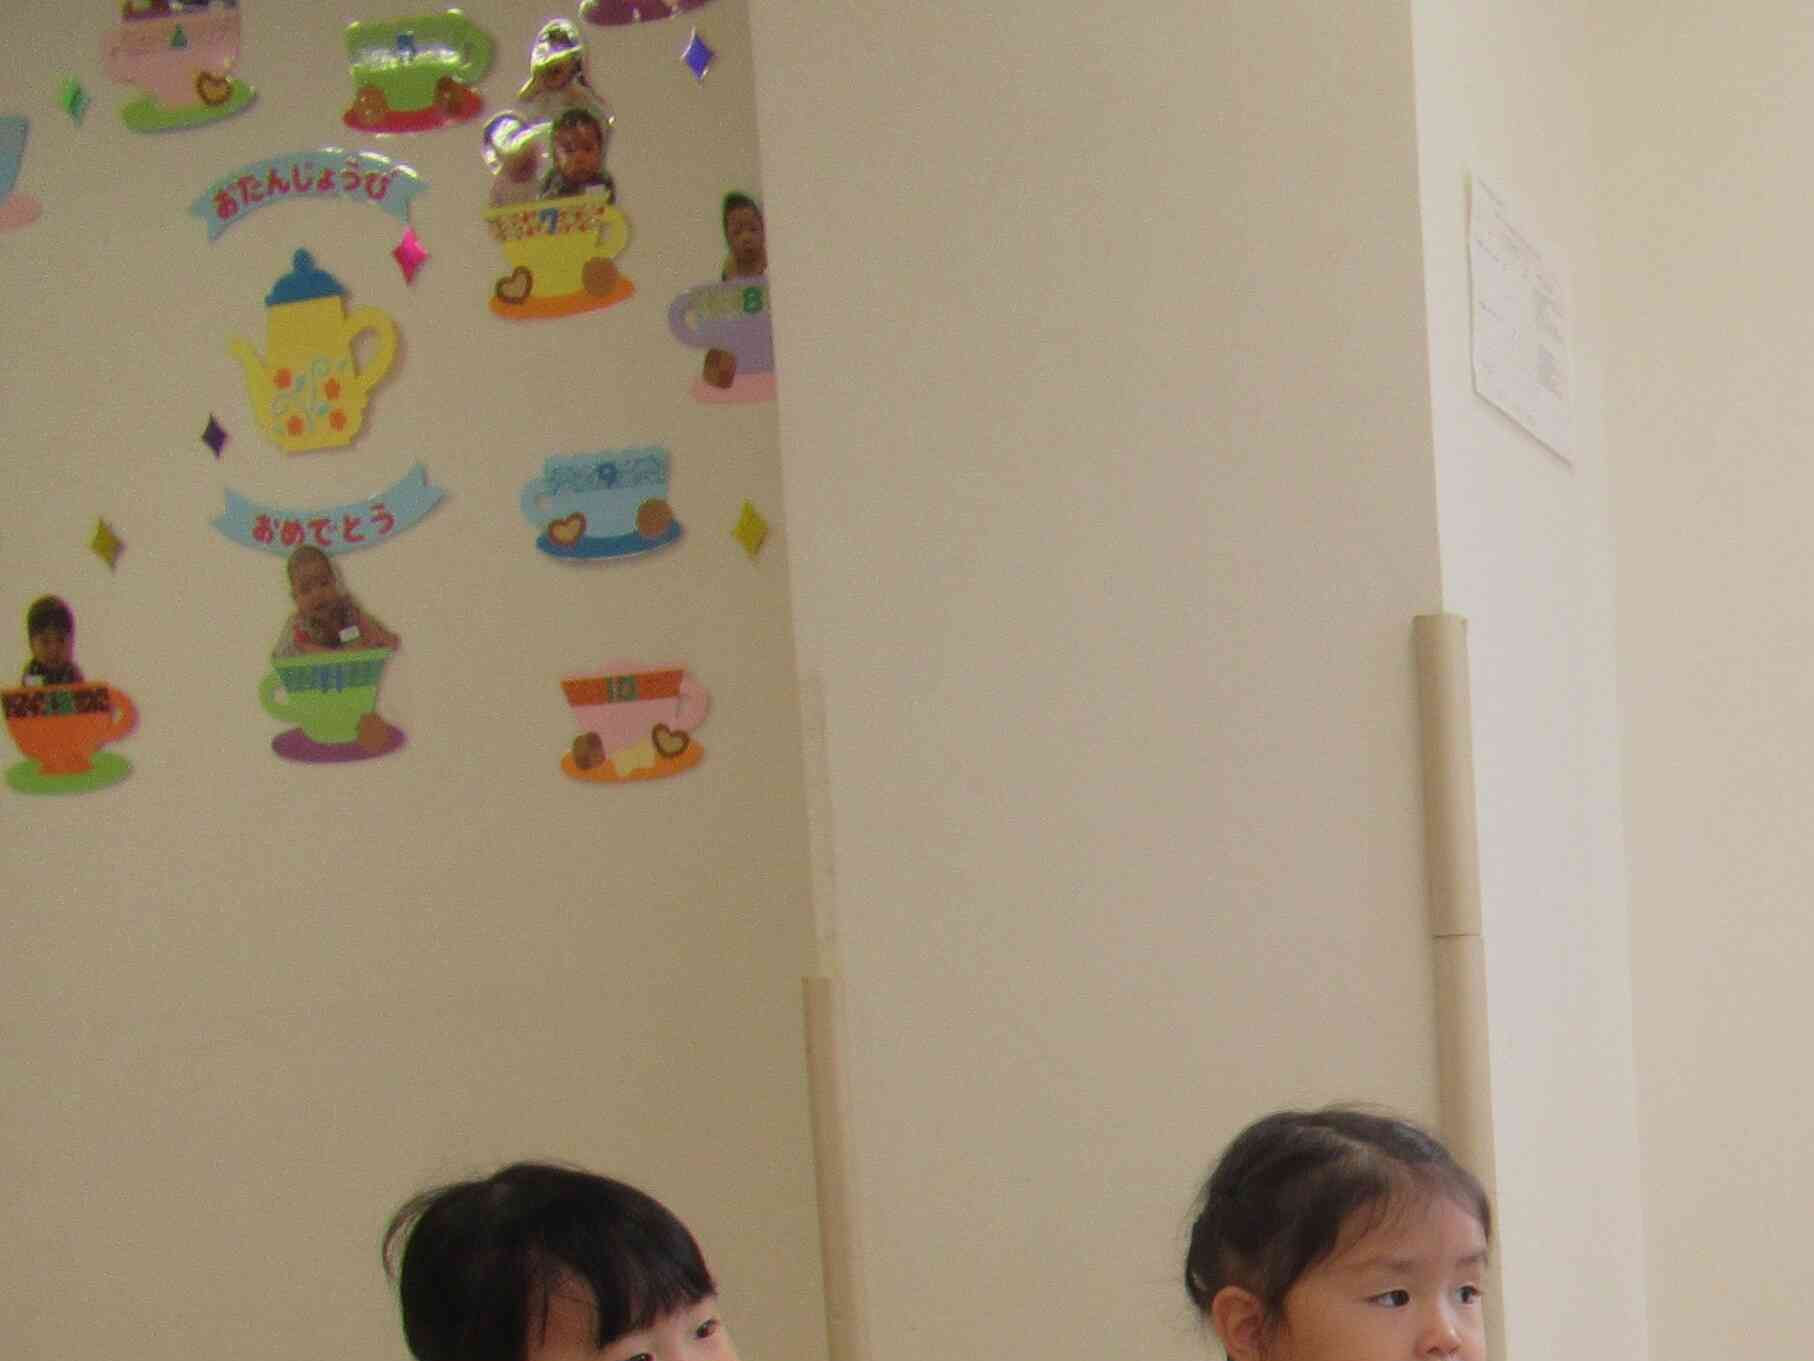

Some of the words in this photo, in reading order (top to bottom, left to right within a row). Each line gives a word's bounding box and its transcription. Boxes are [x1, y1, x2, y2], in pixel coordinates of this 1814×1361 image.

[213, 155, 401, 220] おたんじょうび
[743, 286, 763, 314] 8
[598, 463, 618, 488] 9
[252, 502, 395, 547] おめでとう
